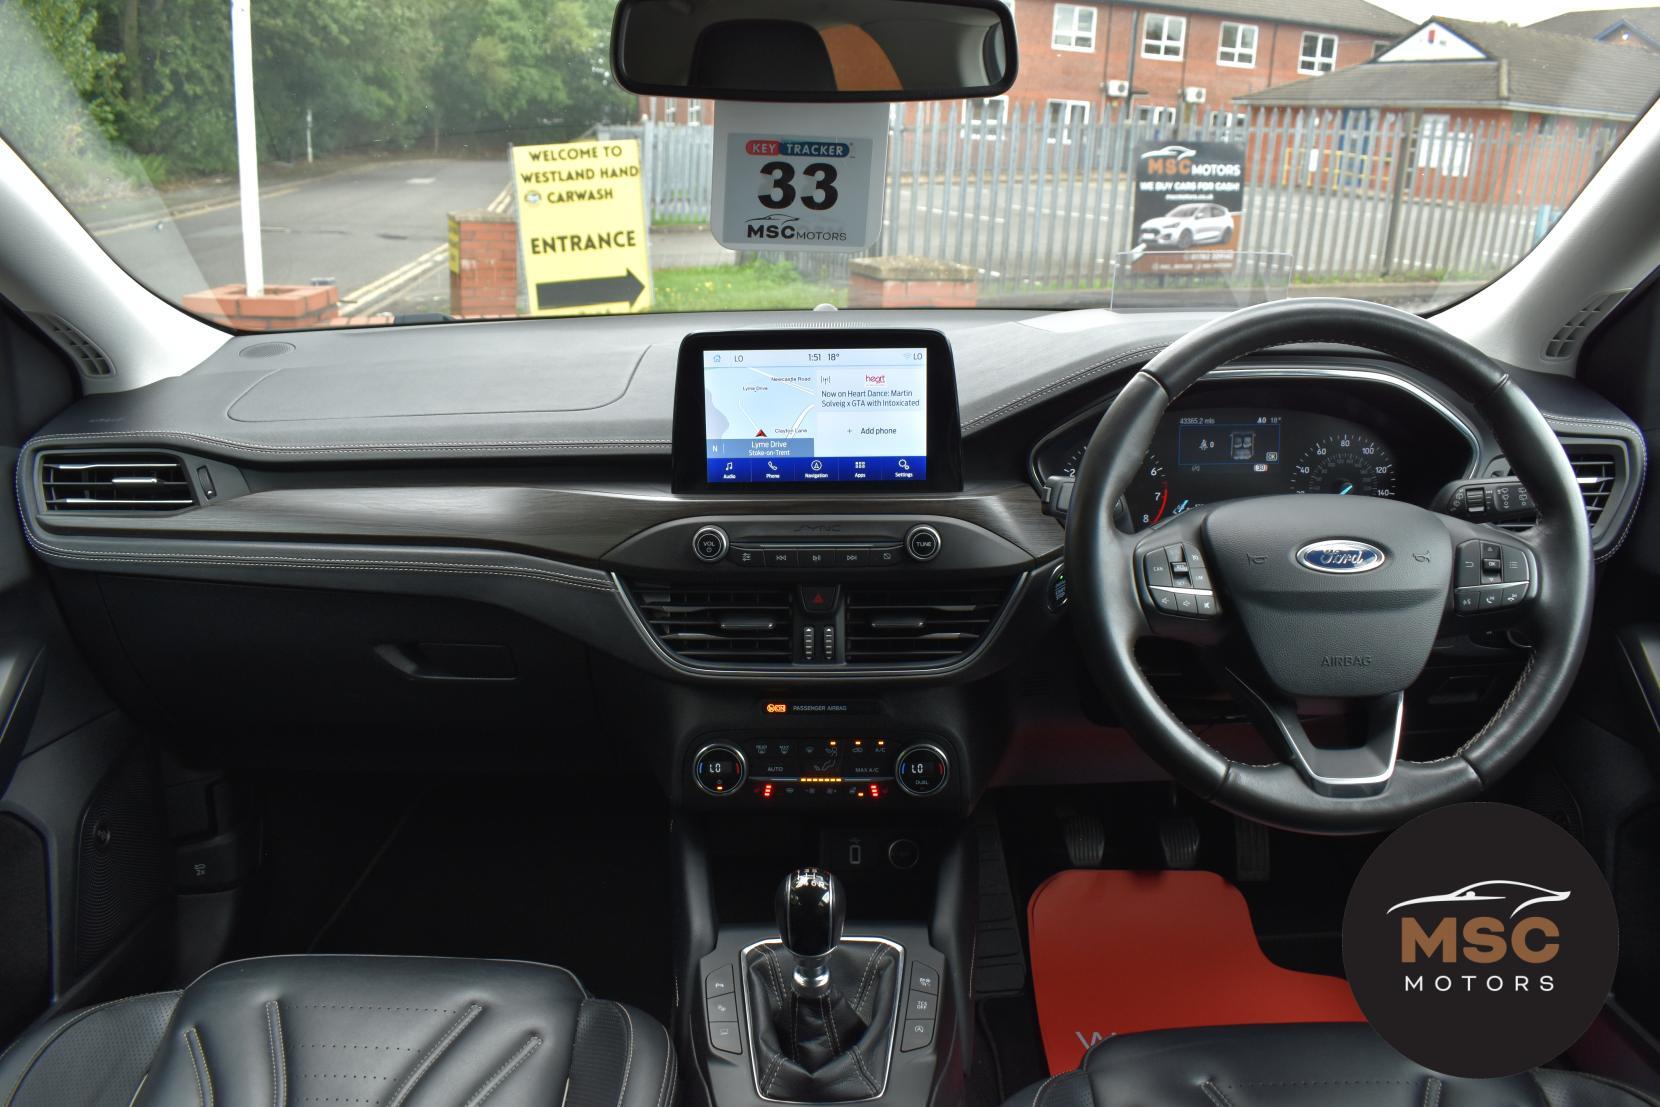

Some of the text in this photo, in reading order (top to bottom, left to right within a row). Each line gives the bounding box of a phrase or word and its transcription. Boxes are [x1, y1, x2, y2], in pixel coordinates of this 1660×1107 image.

[529, 145, 622, 162] WELCOME TO
[752, 144, 843, 155] KEY TRACKER
[1148, 159, 1241, 176] MSC MOTORS
[521, 166, 639, 183] WESTLAND HAND
[758, 161, 838, 210] 33
[547, 188, 613, 204] CARWASH
[747, 224, 847, 241] MSC MOTORS
[530, 230, 636, 254] ENTRANCE
[734, 355, 744, 363] LO
[808, 353, 821, 361] 1:51
[913, 353, 923, 361] LO
[865, 374, 886, 384] heart
[821, 390, 837, 398] Now
[867, 390, 890, 398] Dance:
[890, 389, 913, 397] Martin
[821, 400, 846, 409] Solveig
[867, 399, 882, 407] with
[882, 399, 920, 407] Intoxicated
[860, 427, 897, 436] Add phone
[751, 440, 787, 449] Lyme Drive
[748, 449, 790, 457] Stoke-on-Trent
[1362, 447, 1374, 455] 100
[1069, 468, 1076, 478] 2
[1150, 467, 1157, 476] 6
[1300, 466, 1310, 474] 40
[1375, 466, 1387, 474] 120
[1154, 492, 1161, 501] 7
[1142, 514, 1149, 523] 8
[1320, 549, 1364, 564] Ford
[1321, 655, 1371, 667] AIRBAG
